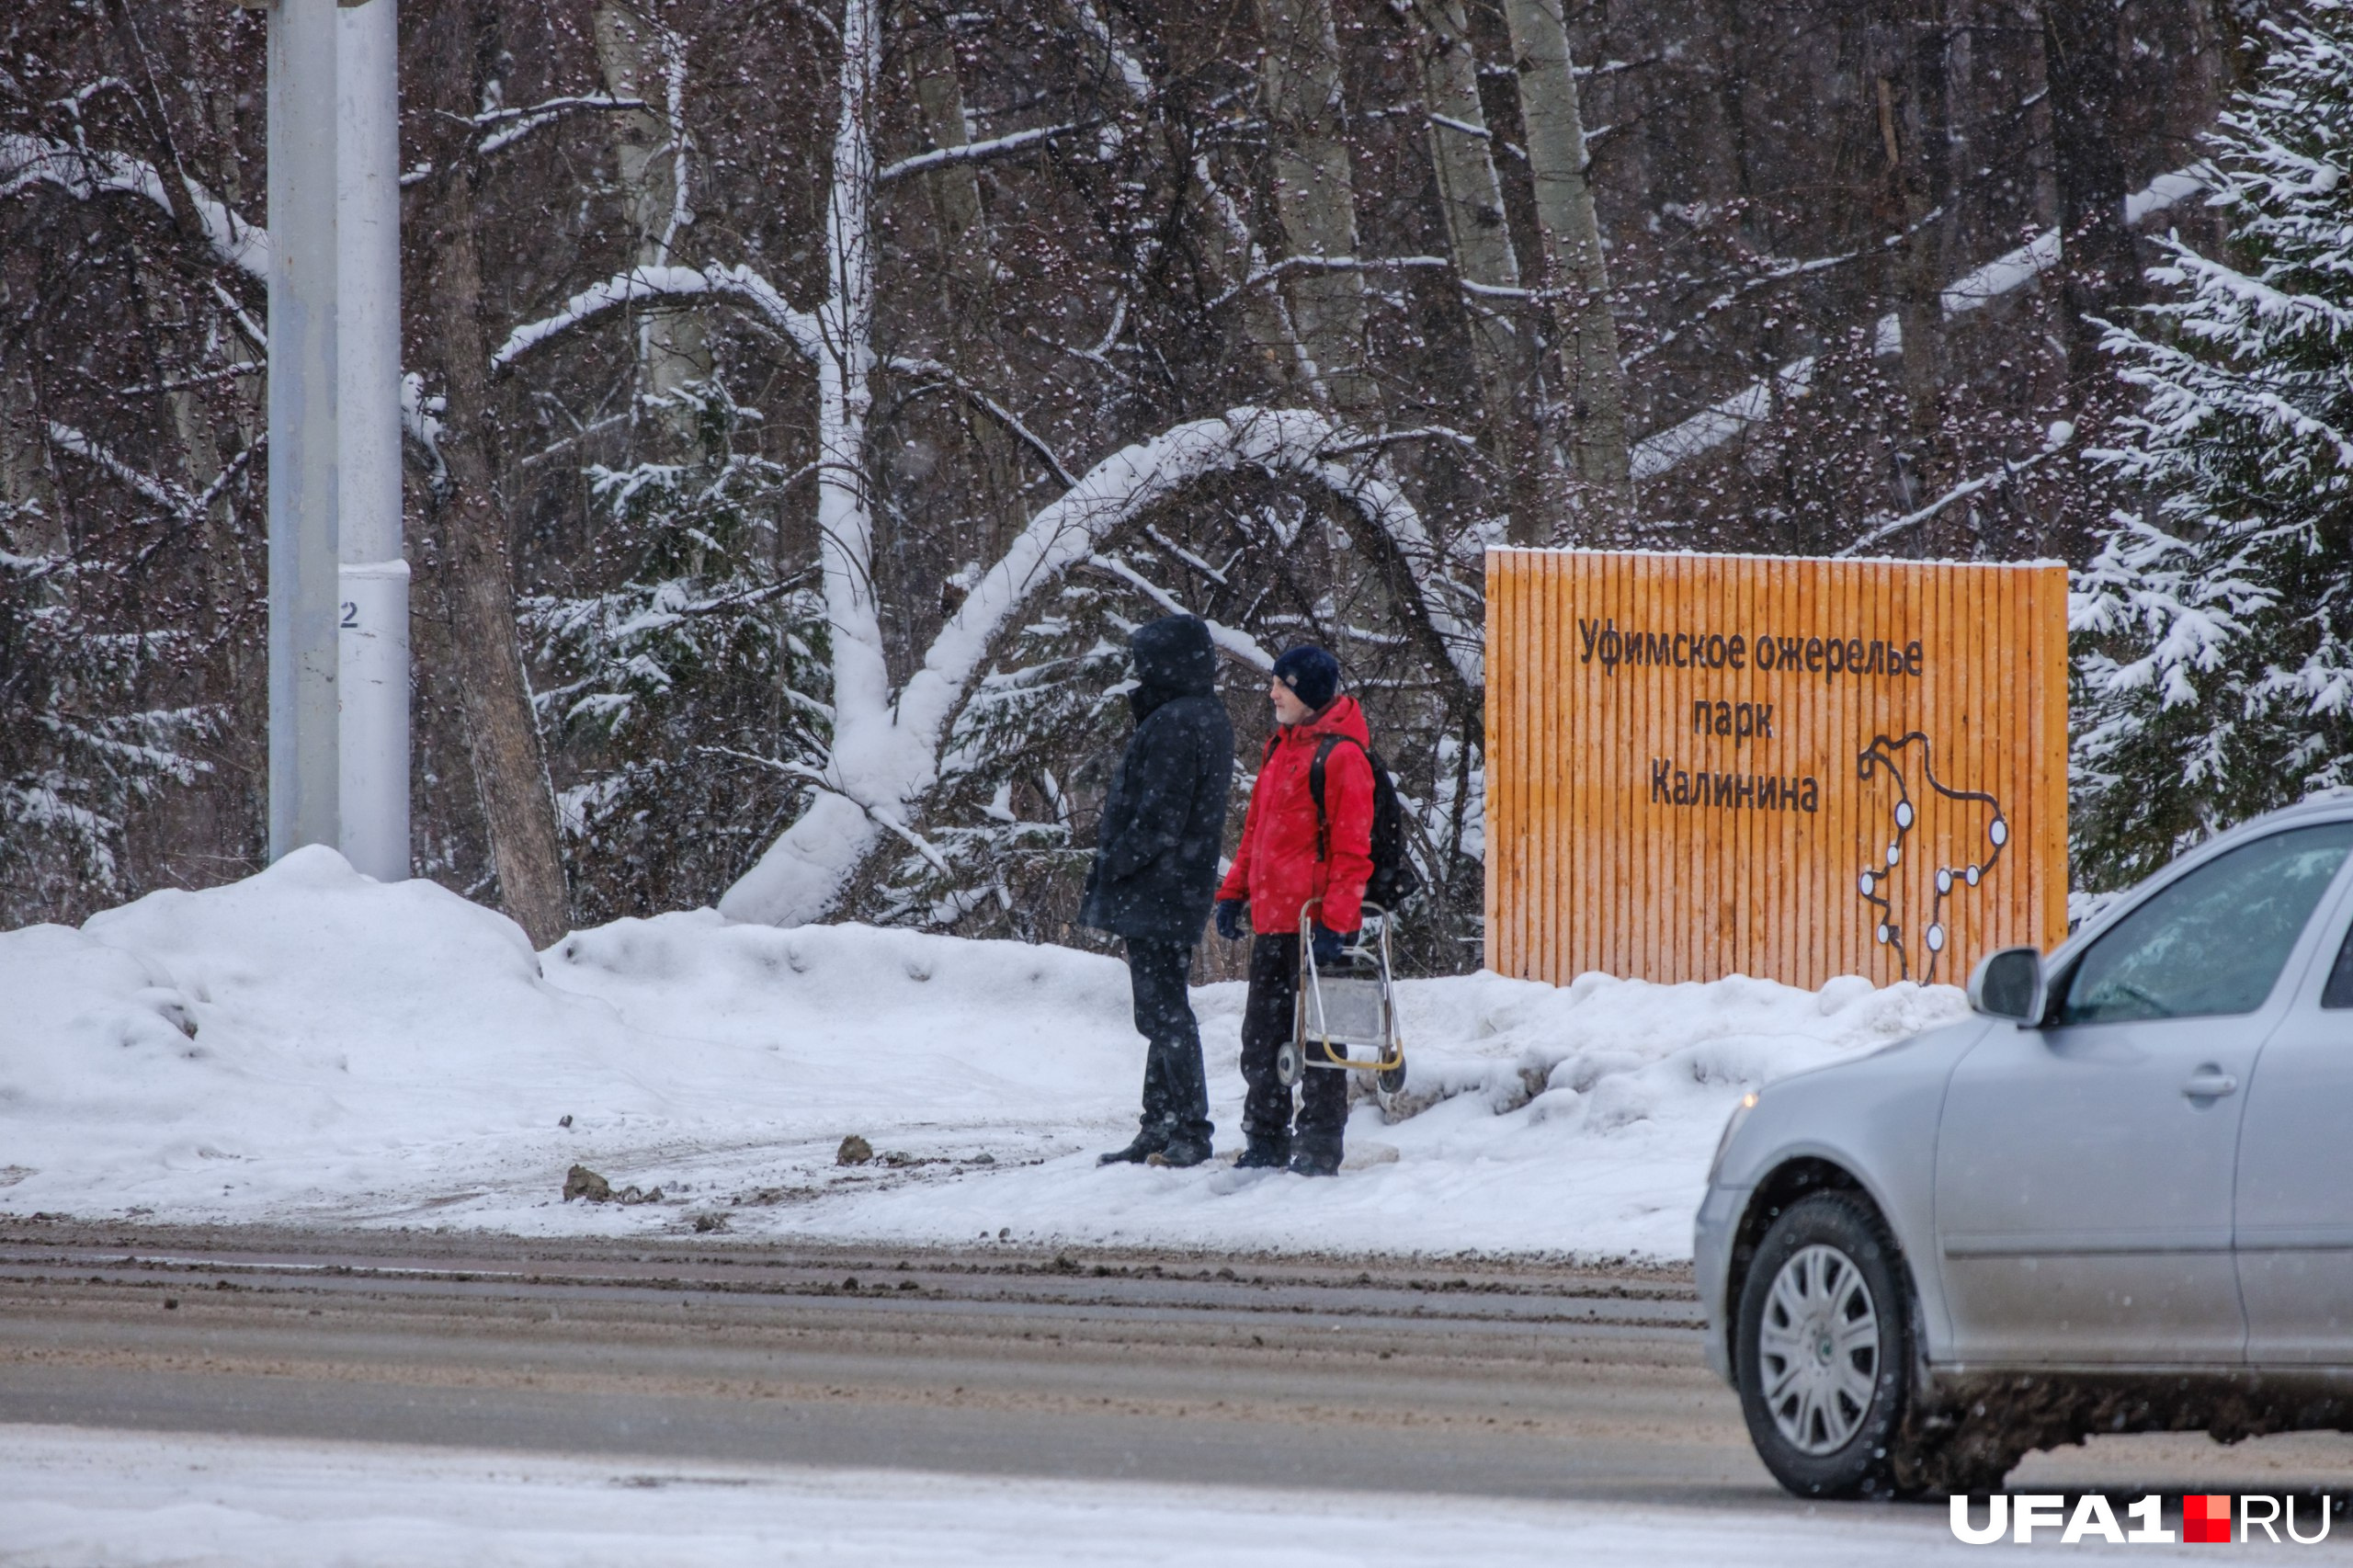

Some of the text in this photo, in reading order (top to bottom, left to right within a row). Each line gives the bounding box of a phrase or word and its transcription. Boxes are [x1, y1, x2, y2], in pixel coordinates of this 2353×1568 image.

[340, 601, 358, 629] 2
[1578, 618, 1924, 683] Уфимское ожерелье
[1694, 699, 1774, 747] парк
[1652, 758, 1819, 813] Калинина
